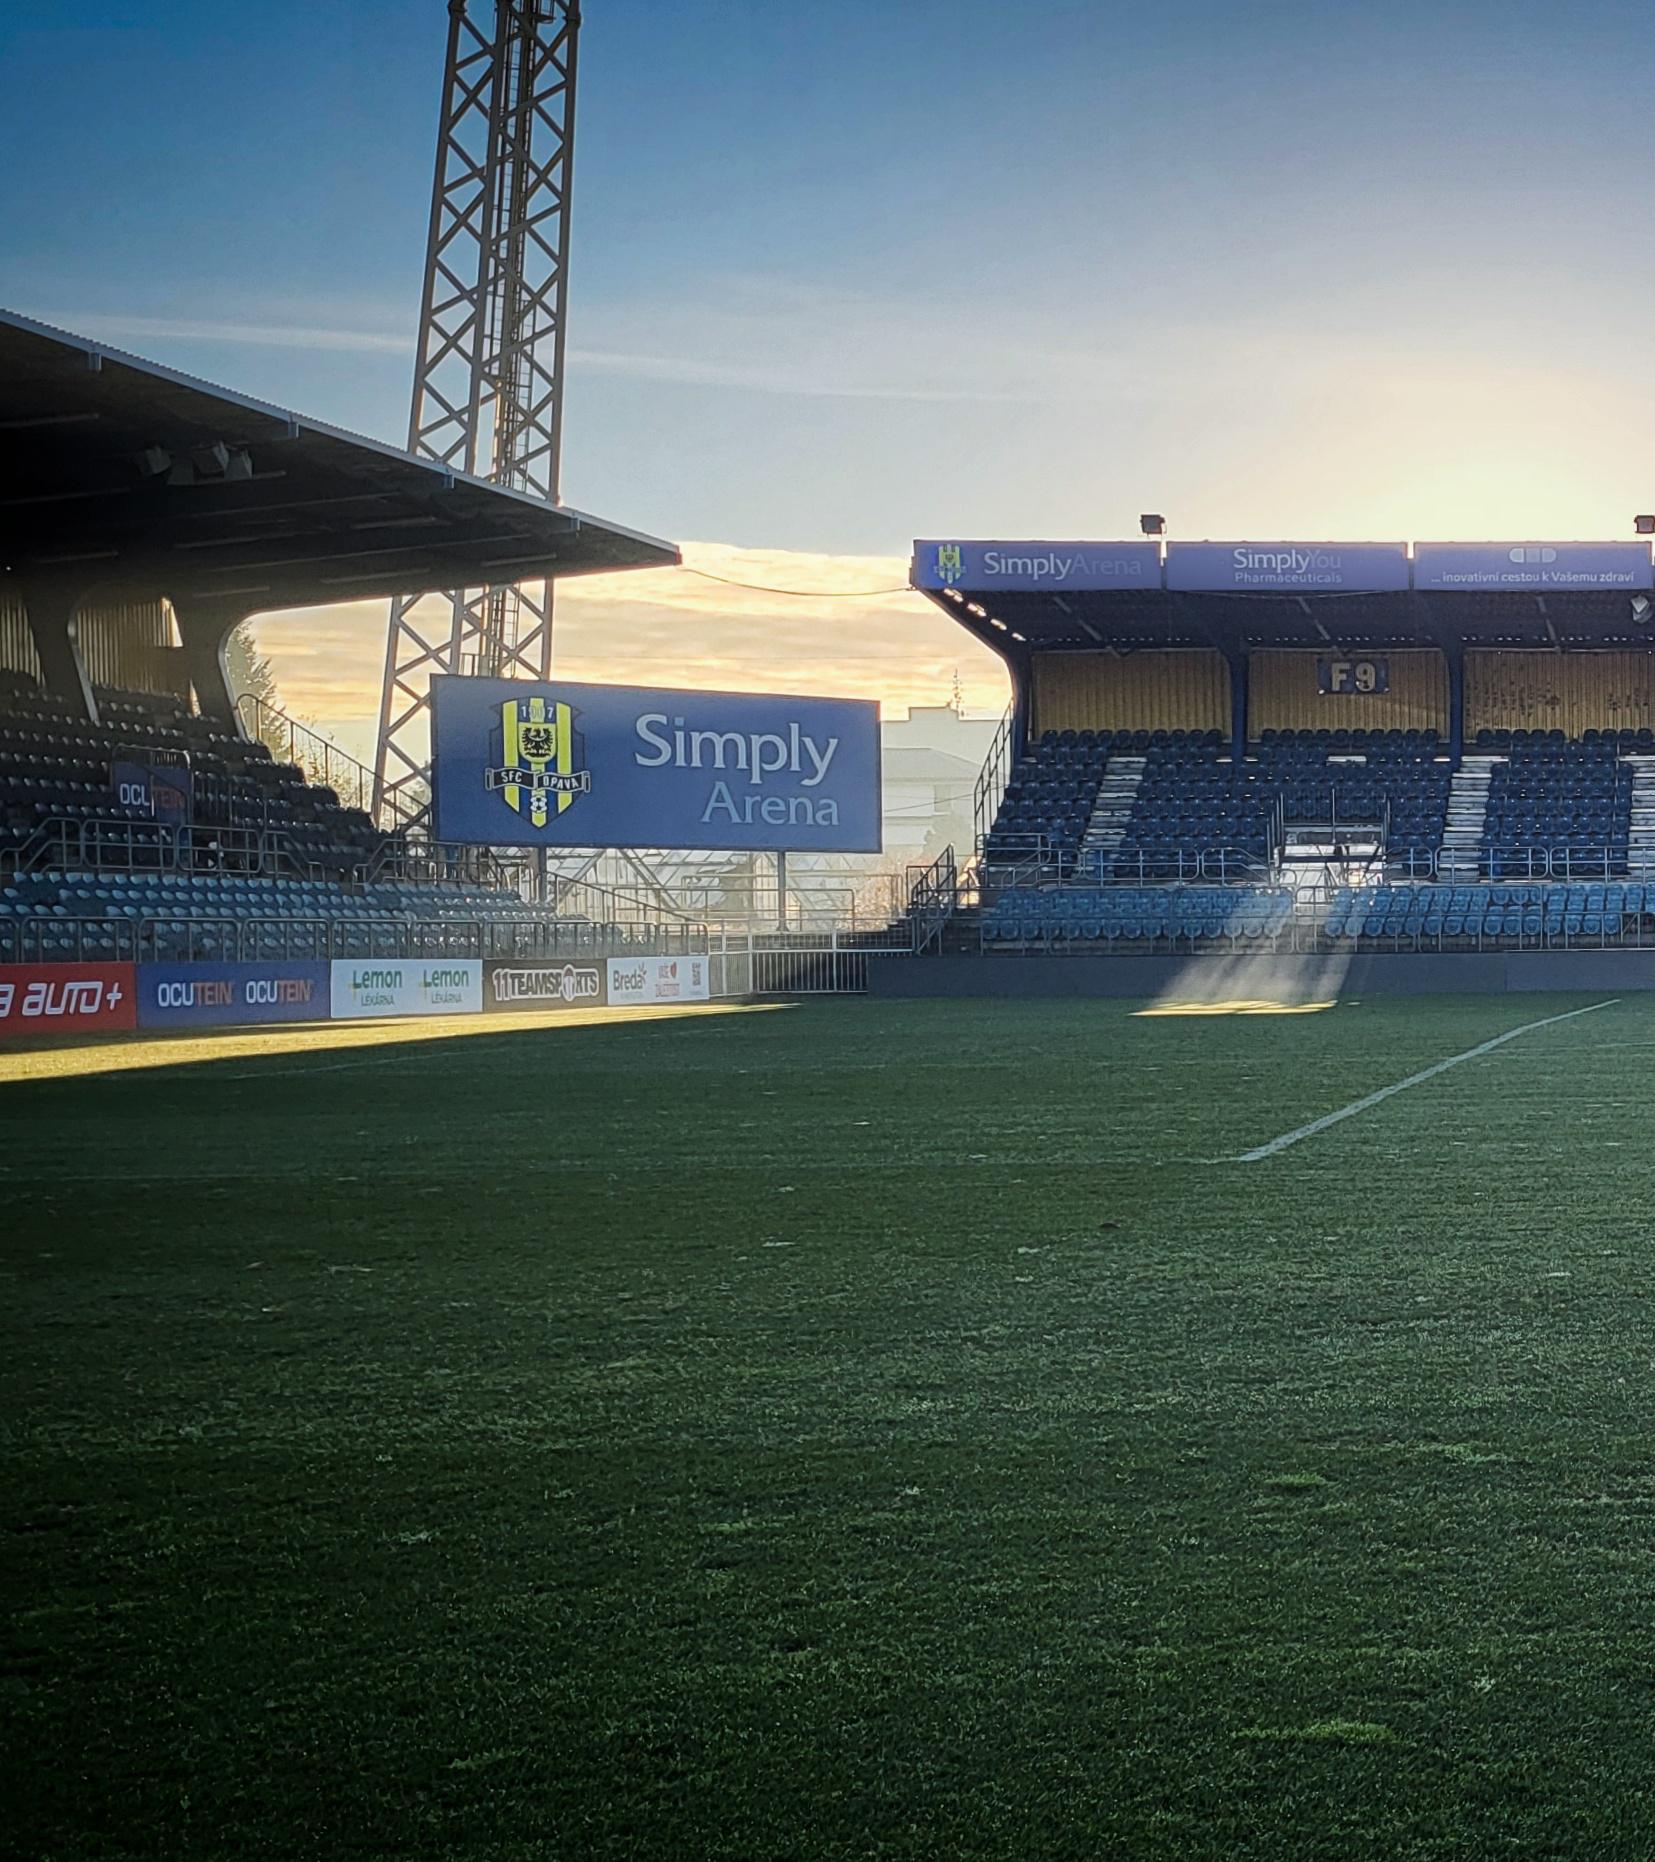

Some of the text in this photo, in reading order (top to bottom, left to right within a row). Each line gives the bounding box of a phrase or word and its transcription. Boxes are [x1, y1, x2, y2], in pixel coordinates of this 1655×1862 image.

[984, 551, 1142, 580] SimplyArena
[1233, 548, 1342, 573] SimplyYou
[1235, 572, 1342, 584] Pharmaceuticals
[1501, 572, 1540, 583] cestou
[1542, 571, 1550, 583] k
[1552, 571, 1598, 583] Vašemu
[635, 713, 839, 787] Simply
[501, 772, 579, 788] SFC OPAVA
[700, 781, 840, 827] Arena
[353, 969, 469, 989] Lemon Lemon
[613, 969, 643, 991] Breda
[158, 979, 311, 1007] OCUTEIN OCUTEIN
